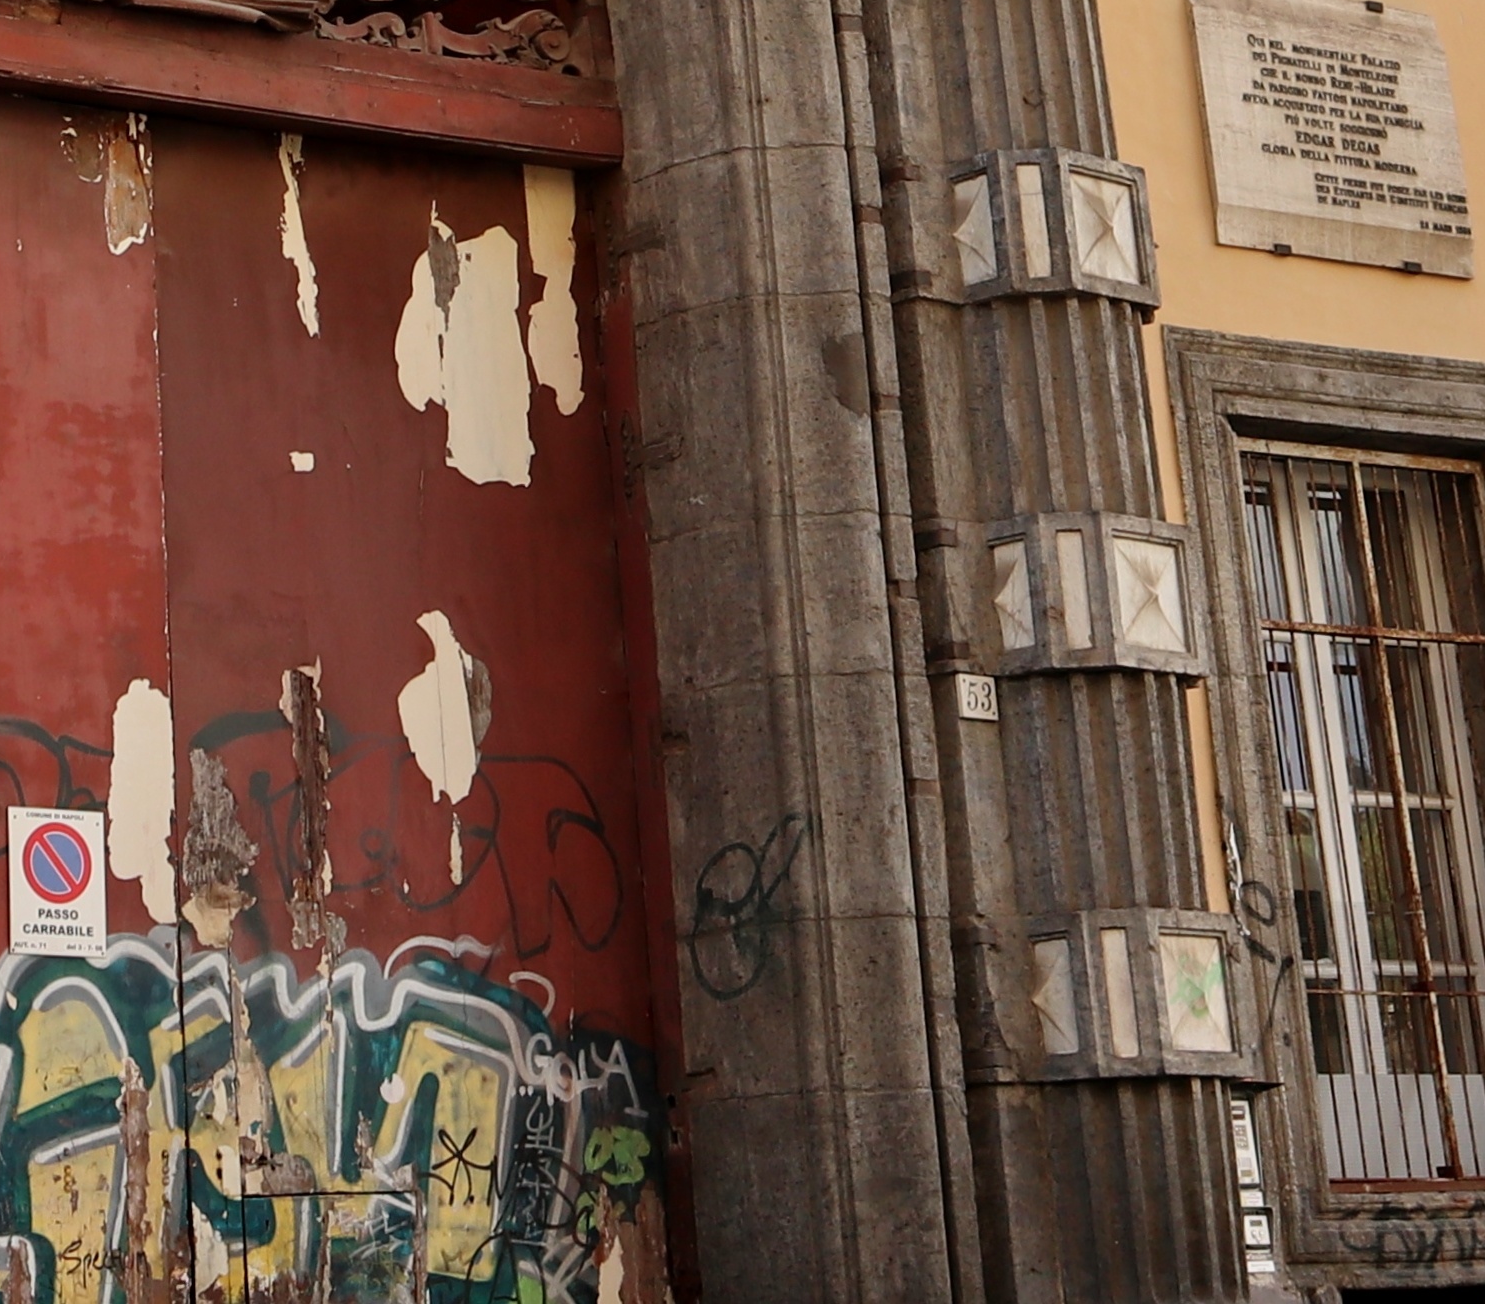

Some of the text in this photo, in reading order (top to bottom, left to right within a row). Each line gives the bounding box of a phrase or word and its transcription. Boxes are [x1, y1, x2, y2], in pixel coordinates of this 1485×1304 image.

[1295, 130, 1380, 156] EDGAR DEGAS
[1261, 143, 1296, 157] GLORIA
[1299, 148, 1331, 162] DELLA
[967, 682, 991, 711] 53
[26, 811, 52, 820] COMUNE
[62, 813, 85, 821] NAPOLI
[38, 908, 79, 921] PASSO
[23, 923, 94, 938] CARRABILE
